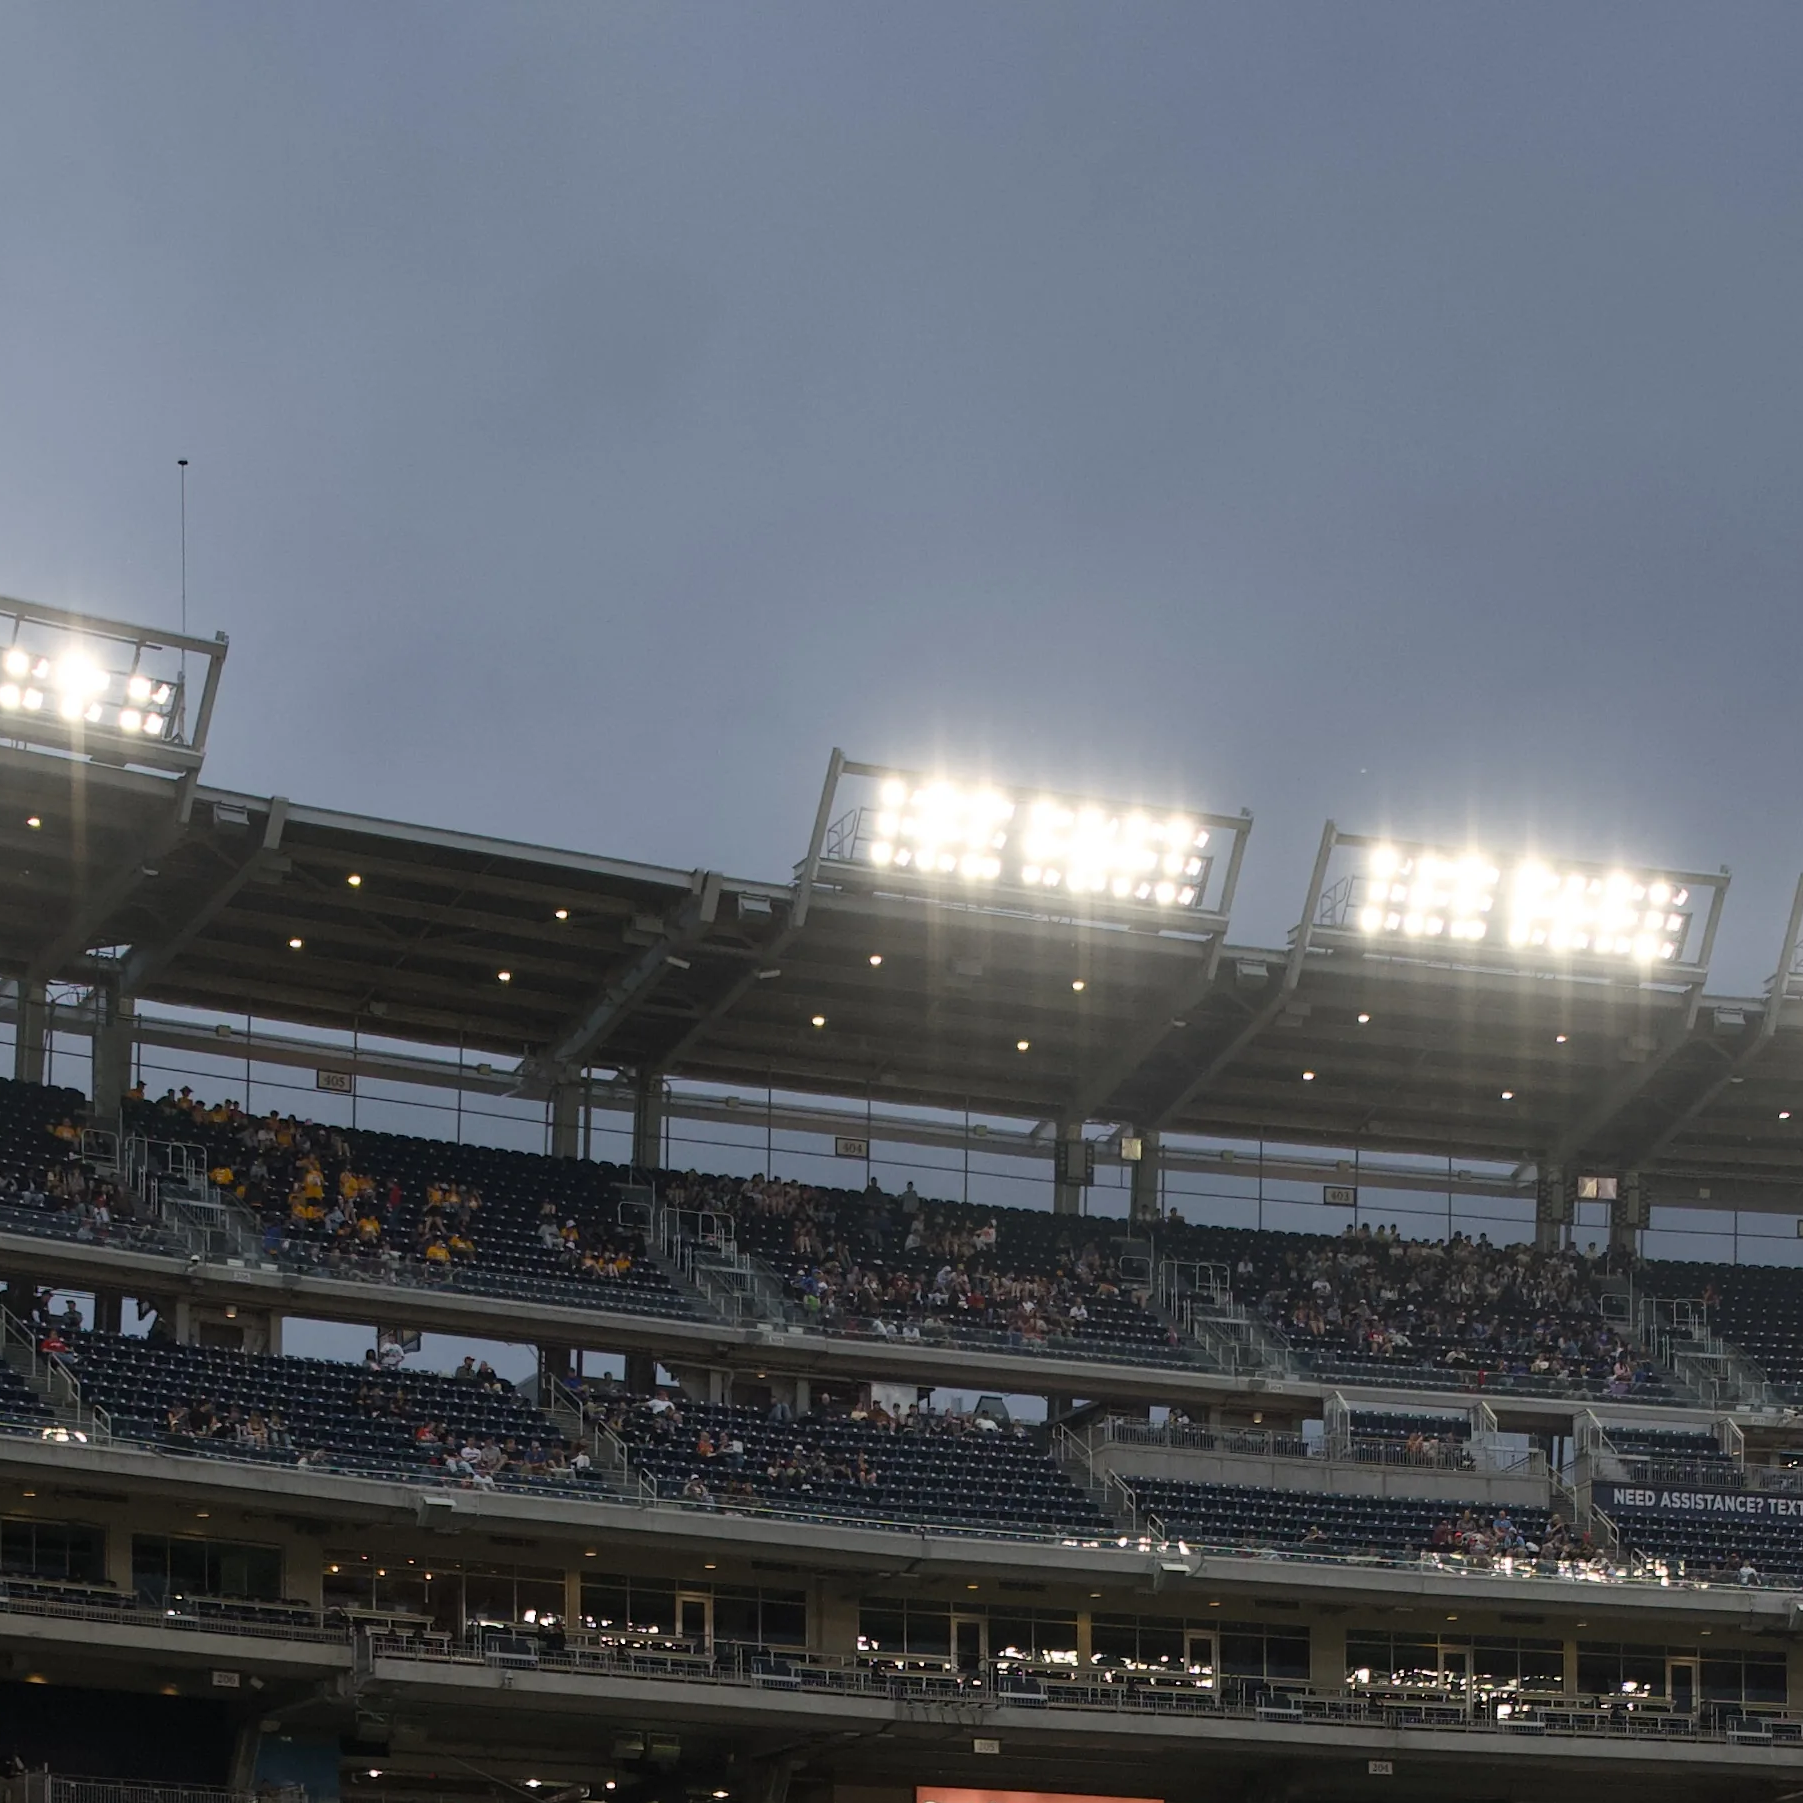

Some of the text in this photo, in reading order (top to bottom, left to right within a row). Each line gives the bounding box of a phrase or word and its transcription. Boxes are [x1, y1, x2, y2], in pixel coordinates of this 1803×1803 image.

[326, 1075, 346, 1088] 405
[1613, 1489, 1656, 1508] NEED
[1660, 1492, 1764, 1513] ASSISTANCE?
